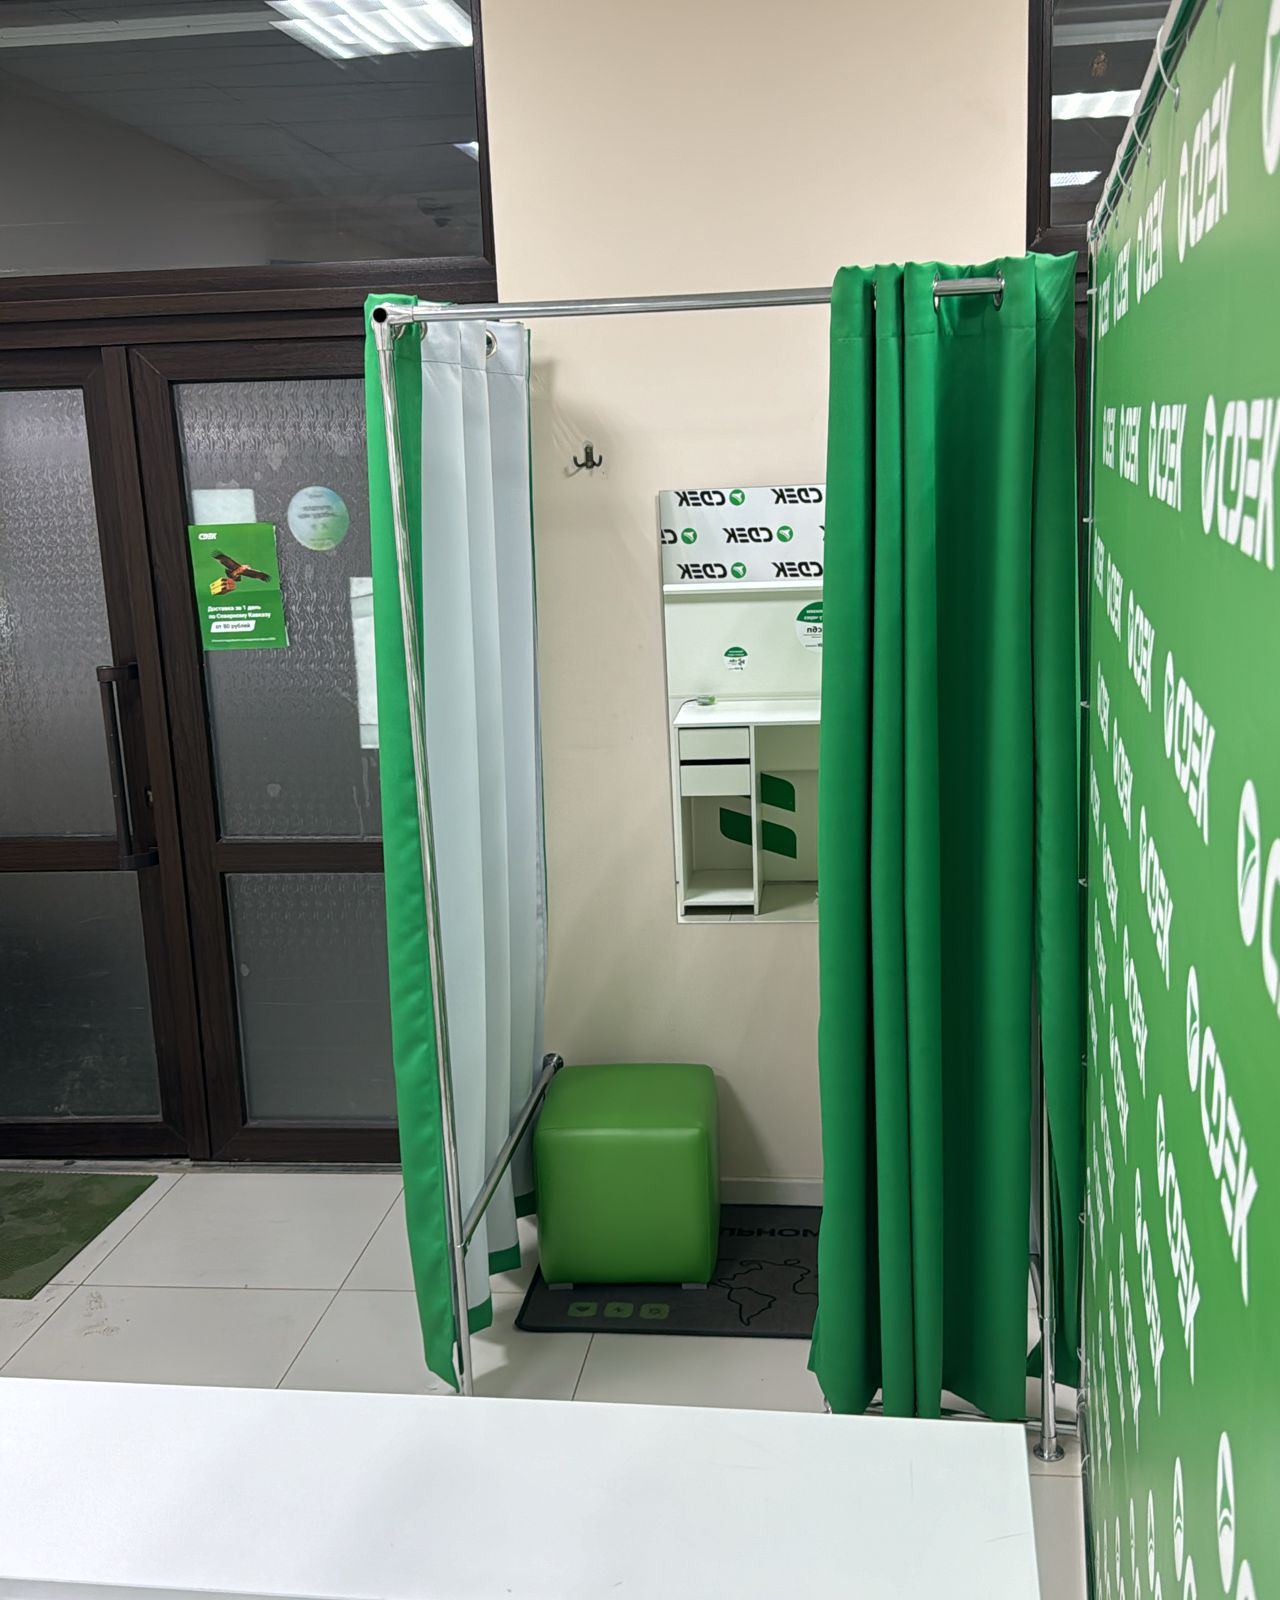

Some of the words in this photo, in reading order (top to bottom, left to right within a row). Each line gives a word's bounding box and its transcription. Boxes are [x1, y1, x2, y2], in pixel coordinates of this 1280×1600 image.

[1143, 178, 1166, 295] CDEK
[1187, 62, 1236, 249] CDEK
[1155, 403, 1187, 512] CDEK
[1217, 398, 1280, 571] CDEK
[1133, 603, 1156, 713] CDEK
[1174, 676, 1215, 846] CDEK
[1147, 836, 1174, 991] CDEK
[1200, 1026, 1258, 1307] CDEK
[1165, 1151, 1200, 1385] CDEK
